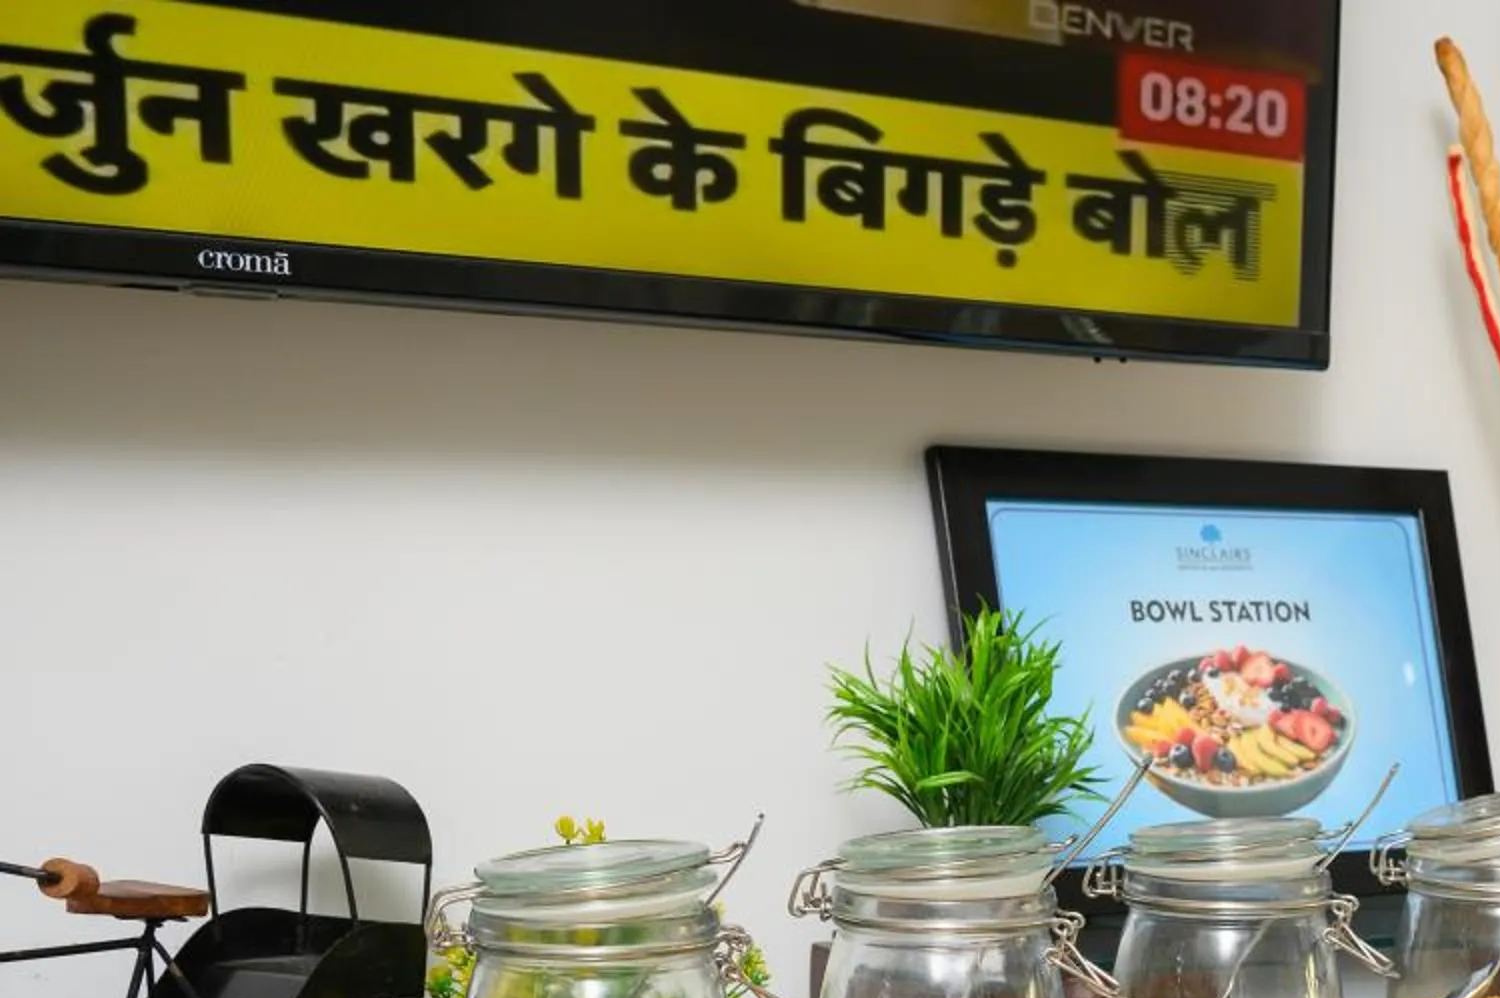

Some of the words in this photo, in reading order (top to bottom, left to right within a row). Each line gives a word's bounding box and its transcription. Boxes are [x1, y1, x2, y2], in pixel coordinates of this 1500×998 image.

[1028, 0, 1195, 53] DENVER
[1139, 71, 1289, 138] 08:20
[272, 72, 596, 199] खरगे
[619, 86, 746, 211] के
[768, 107, 1047, 269] बिगड़े
[1130, 599, 1204, 623] BOWL
[1208, 599, 1311, 623] STATION
